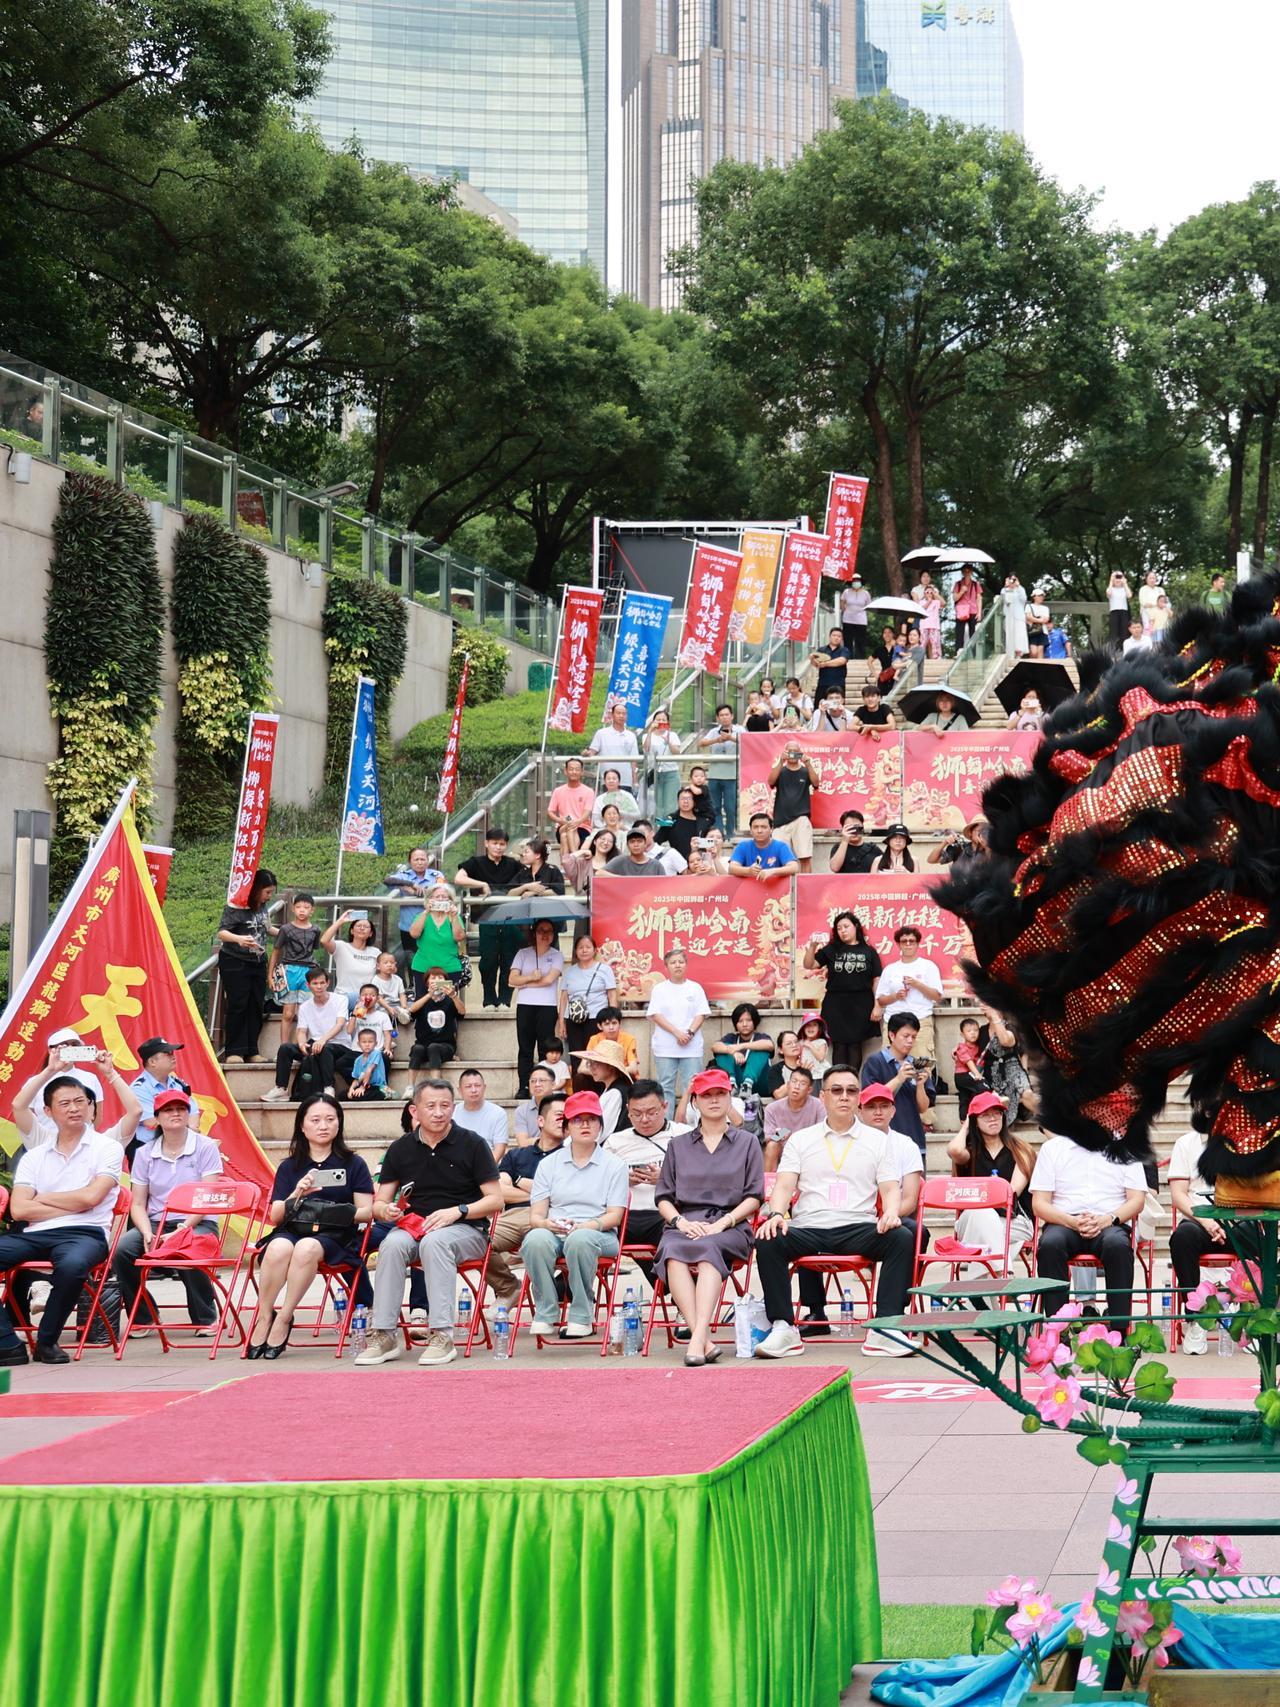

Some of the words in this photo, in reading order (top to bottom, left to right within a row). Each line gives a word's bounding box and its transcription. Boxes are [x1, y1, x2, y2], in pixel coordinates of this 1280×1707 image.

[626, 643, 649, 708] 喜迎全运
[654, 895, 729, 903] 2025年中国狮超·广州站
[627, 904, 751, 961] 狮舞岭南
[672, 937, 755, 957] 喜迎全运
